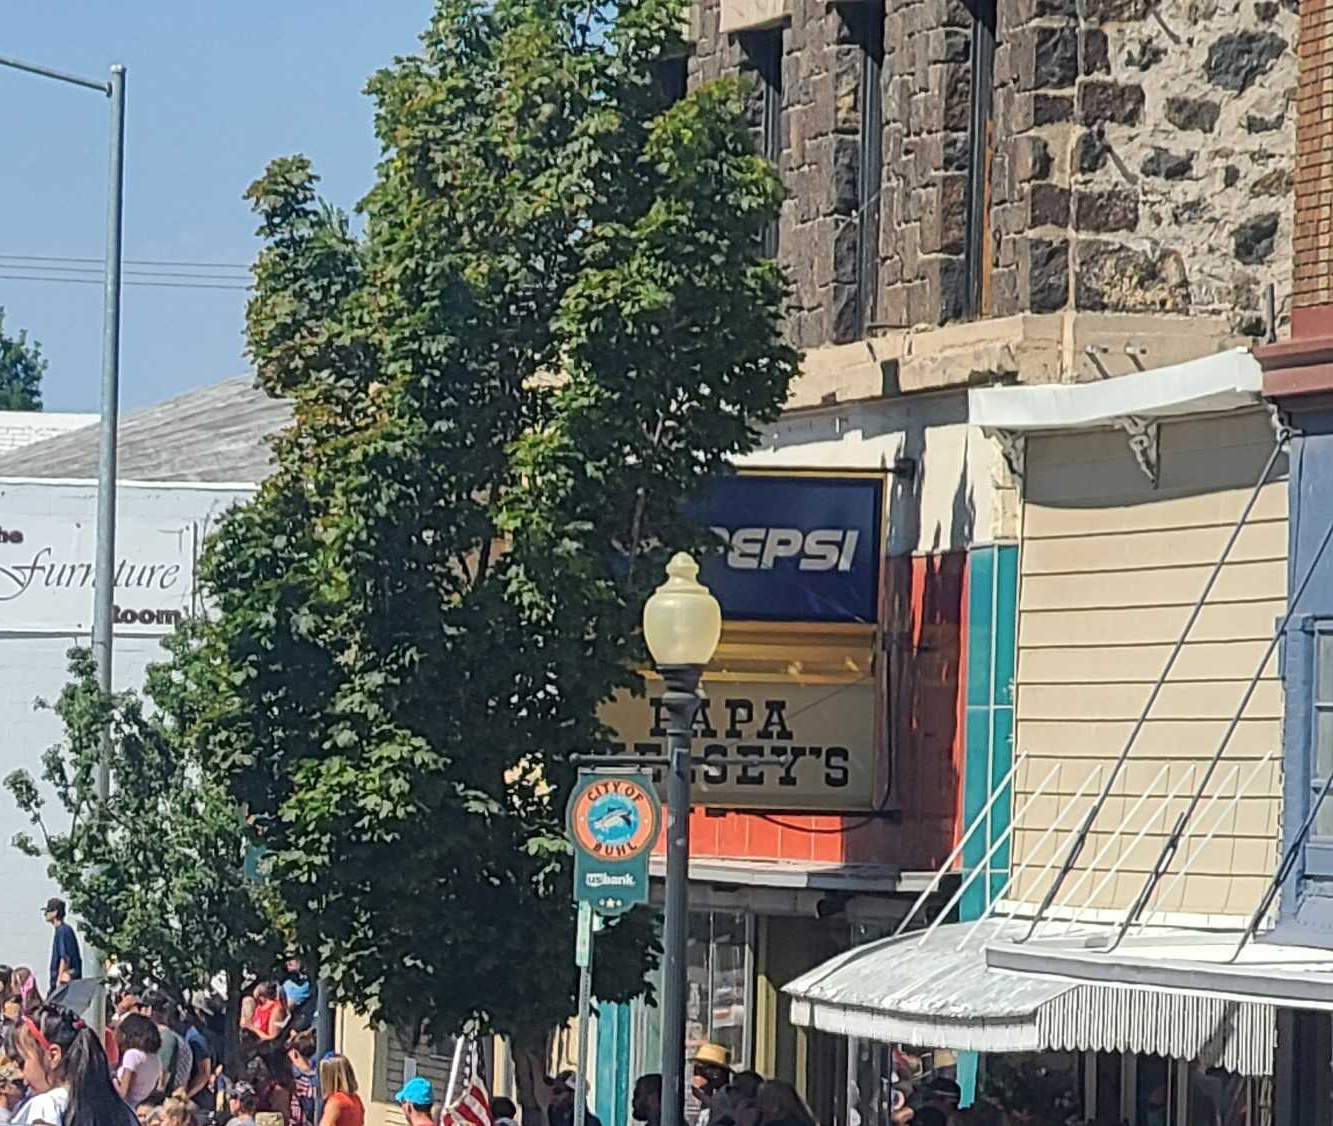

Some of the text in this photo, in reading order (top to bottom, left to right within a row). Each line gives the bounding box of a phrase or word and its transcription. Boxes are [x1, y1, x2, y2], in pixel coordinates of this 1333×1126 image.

[587, 780, 644, 802] CITY OF
[592, 842, 638, 858] BUHL
